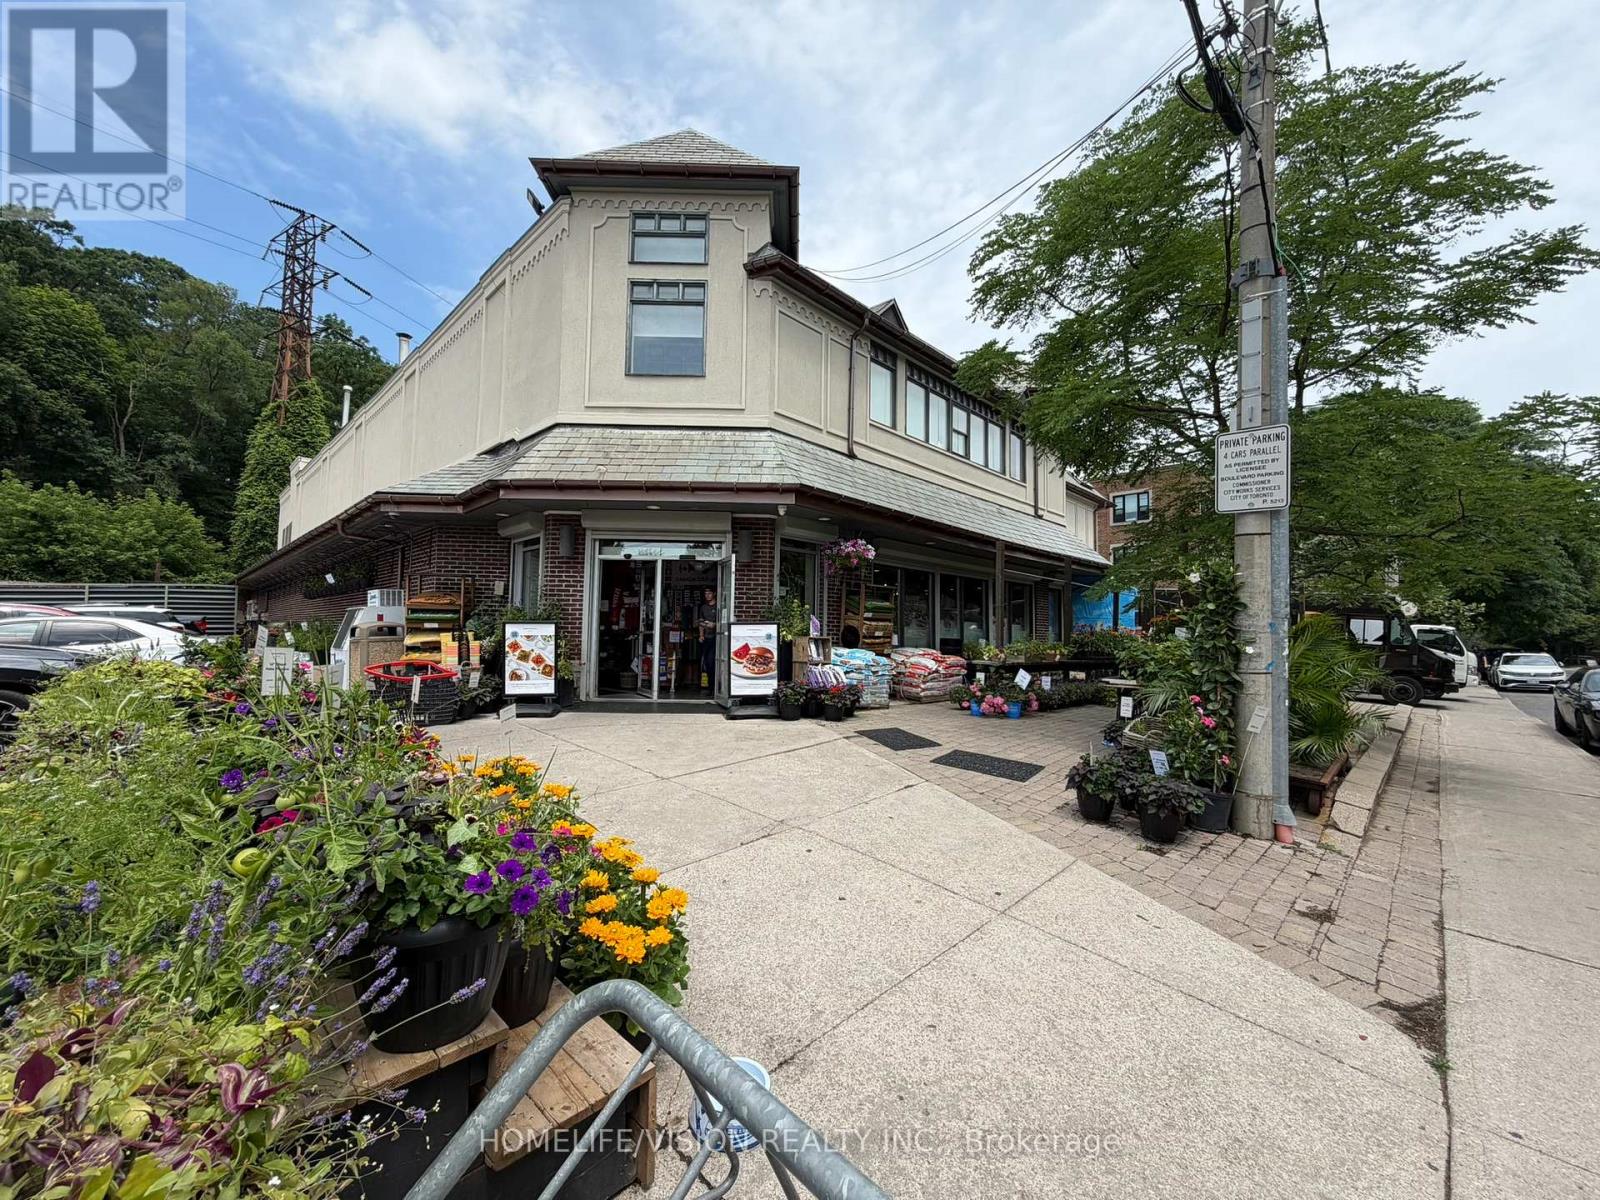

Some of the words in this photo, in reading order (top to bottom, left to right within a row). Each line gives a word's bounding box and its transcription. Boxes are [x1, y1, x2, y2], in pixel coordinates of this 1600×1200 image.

[1220, 437, 1249, 449] PRIVATE
[1252, 432, 1285, 444] PARKING
[1231, 449, 1247, 459] CARS
[1250, 445, 1281, 457] PARALLEL
[1234, 459, 1269, 467] PERMITTED
